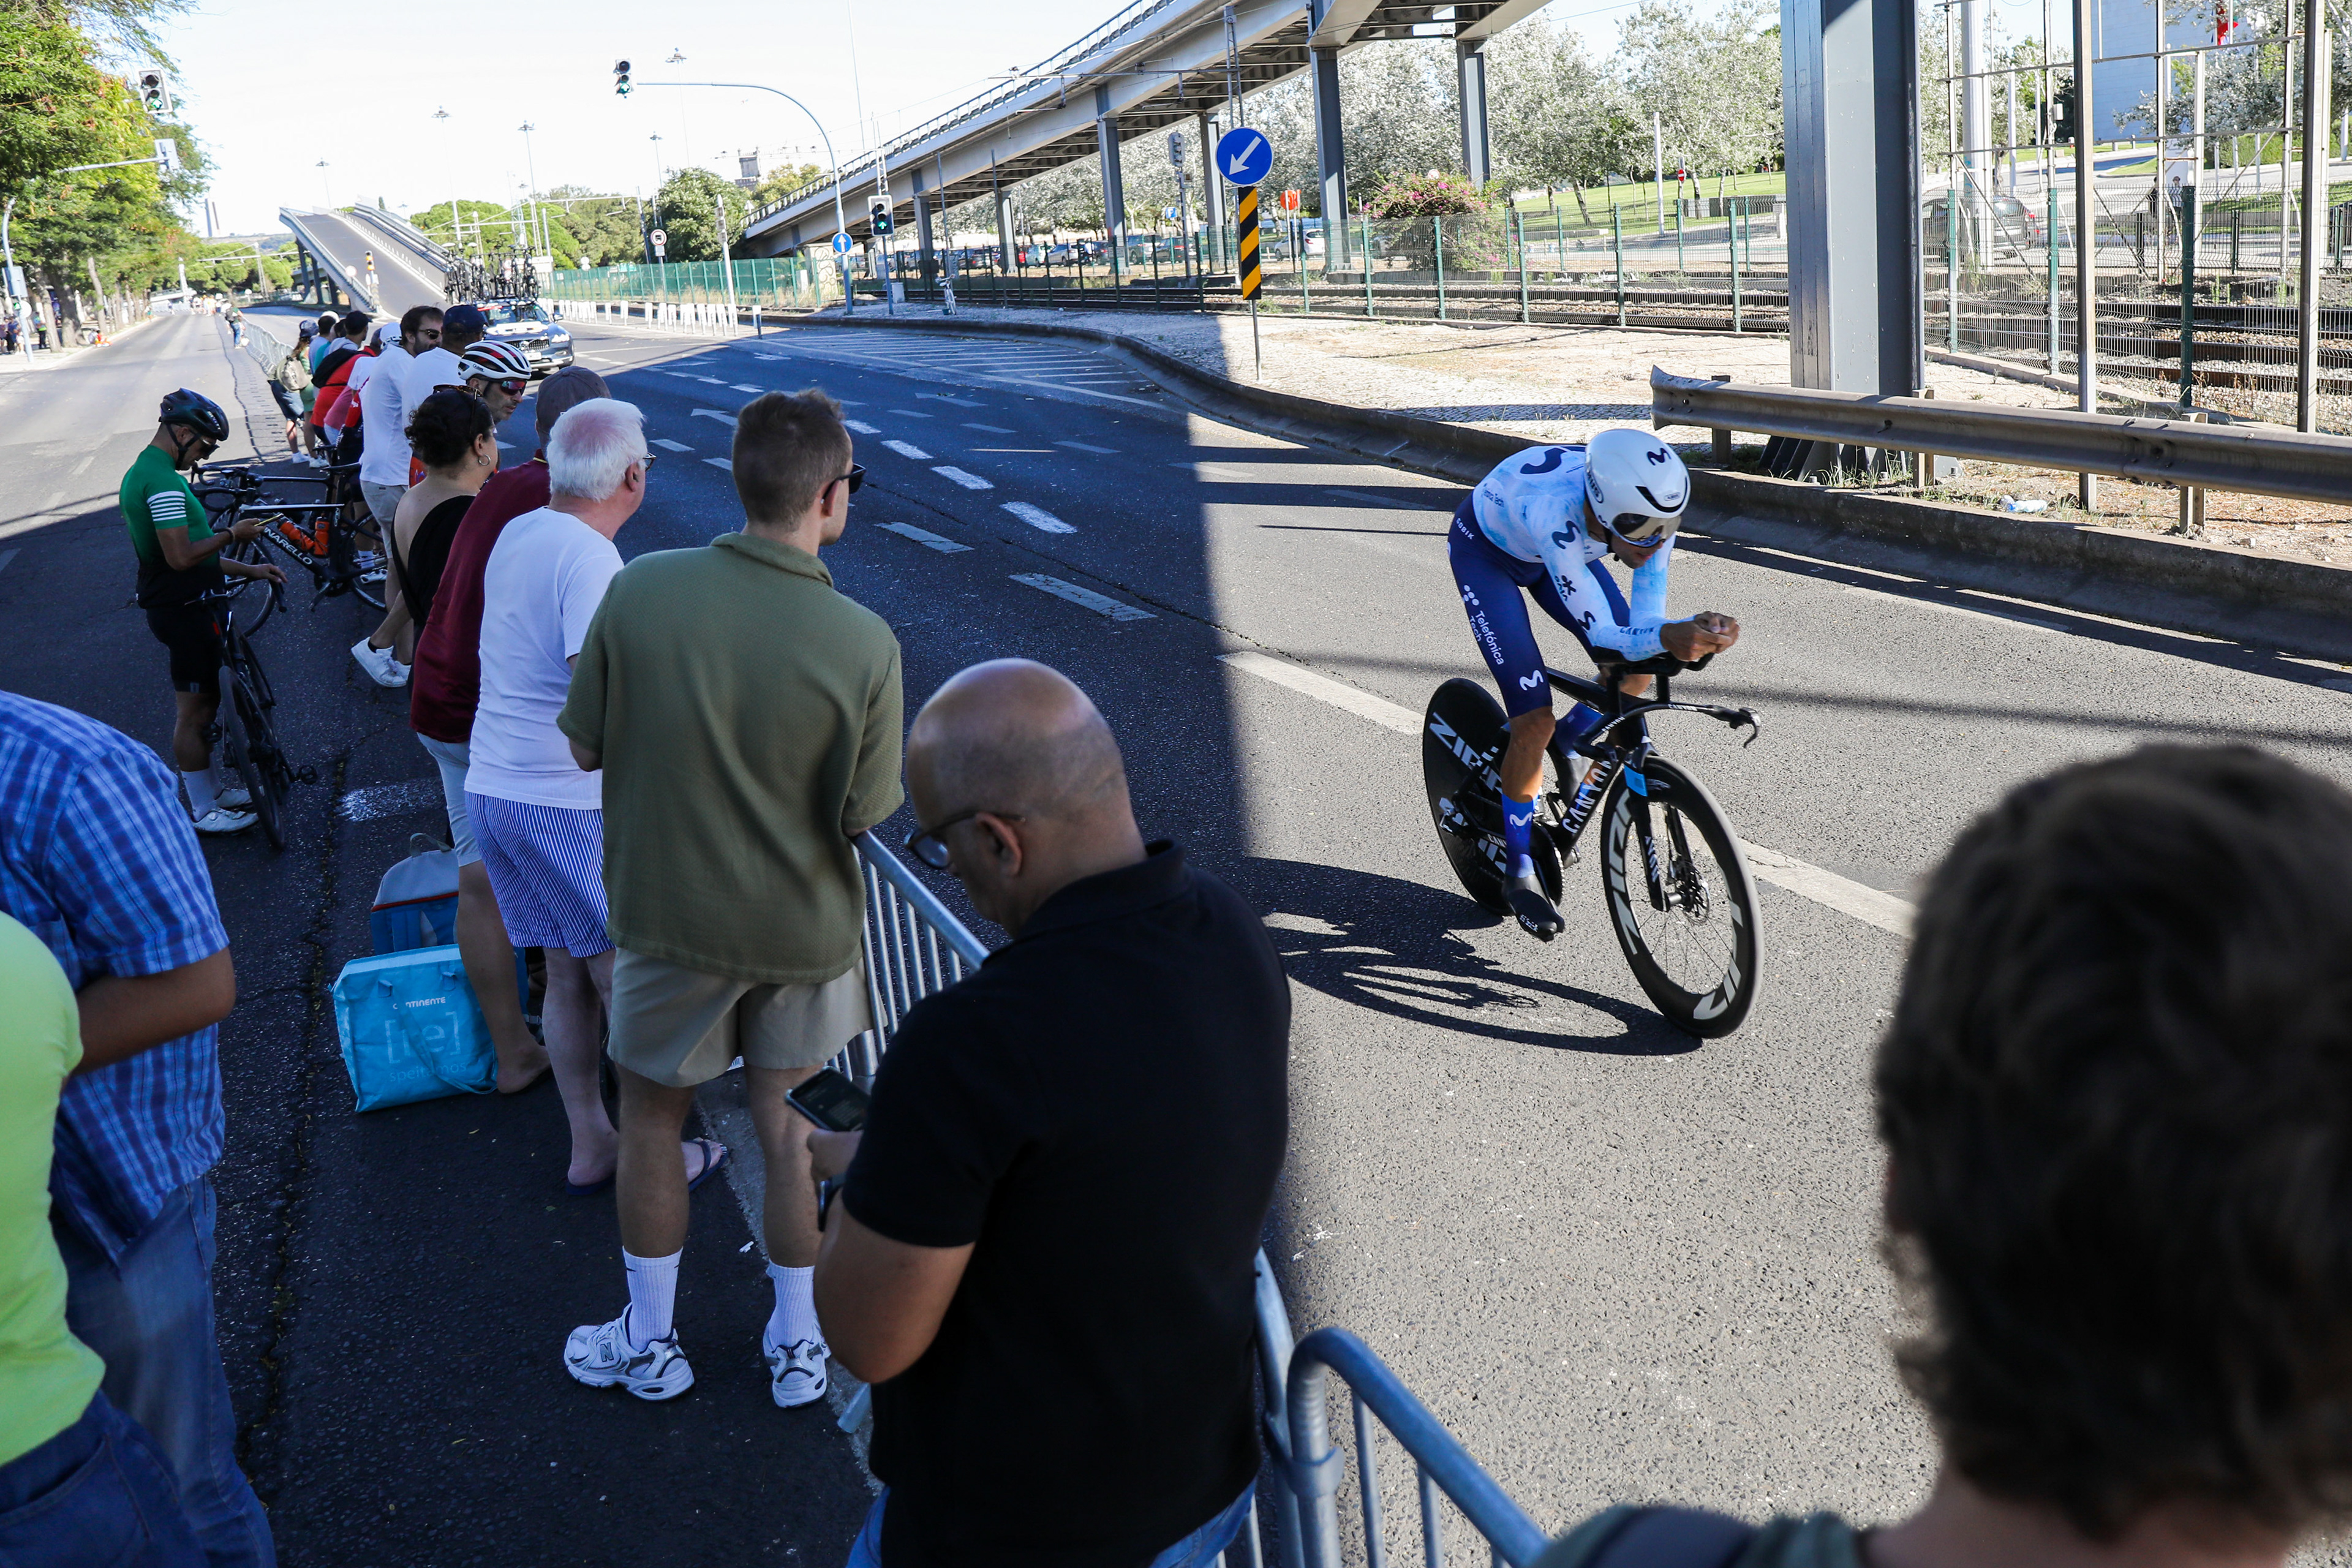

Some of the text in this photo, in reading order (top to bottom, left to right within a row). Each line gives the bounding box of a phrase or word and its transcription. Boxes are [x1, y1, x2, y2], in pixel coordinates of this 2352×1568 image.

[1456, 518, 1475, 540] GOBIK
[264, 527, 313, 565] INARELLO
[1469, 616, 1482, 642] Tech
[1475, 610, 1504, 665] Telefónica
[393, 997, 447, 1009] CNTINENTE
[600, 1342, 614, 1363] N
